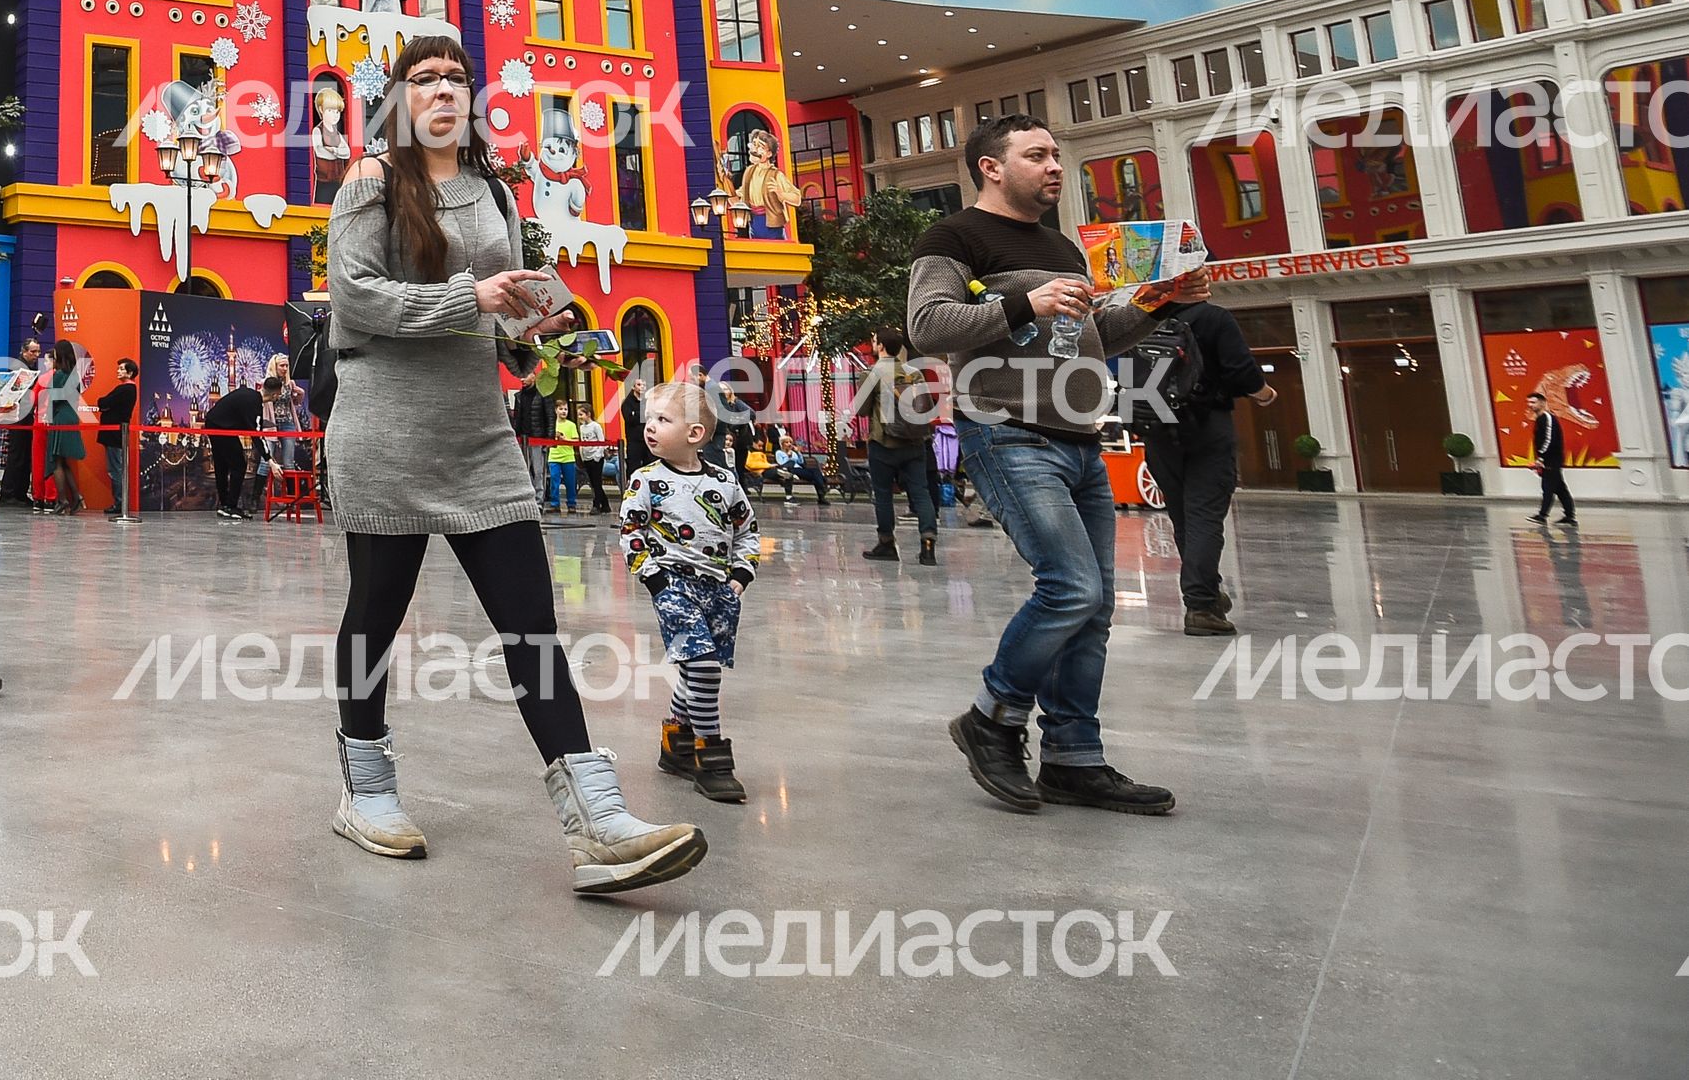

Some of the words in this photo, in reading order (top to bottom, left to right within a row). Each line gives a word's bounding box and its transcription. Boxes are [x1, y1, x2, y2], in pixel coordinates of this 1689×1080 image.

[1209, 260, 1268, 281] ИСЫ
[1278, 245, 1411, 276] SERVICES
[150, 334, 171, 342] ОСТРОВ
[151, 341, 170, 349] МЕЧТЫ
